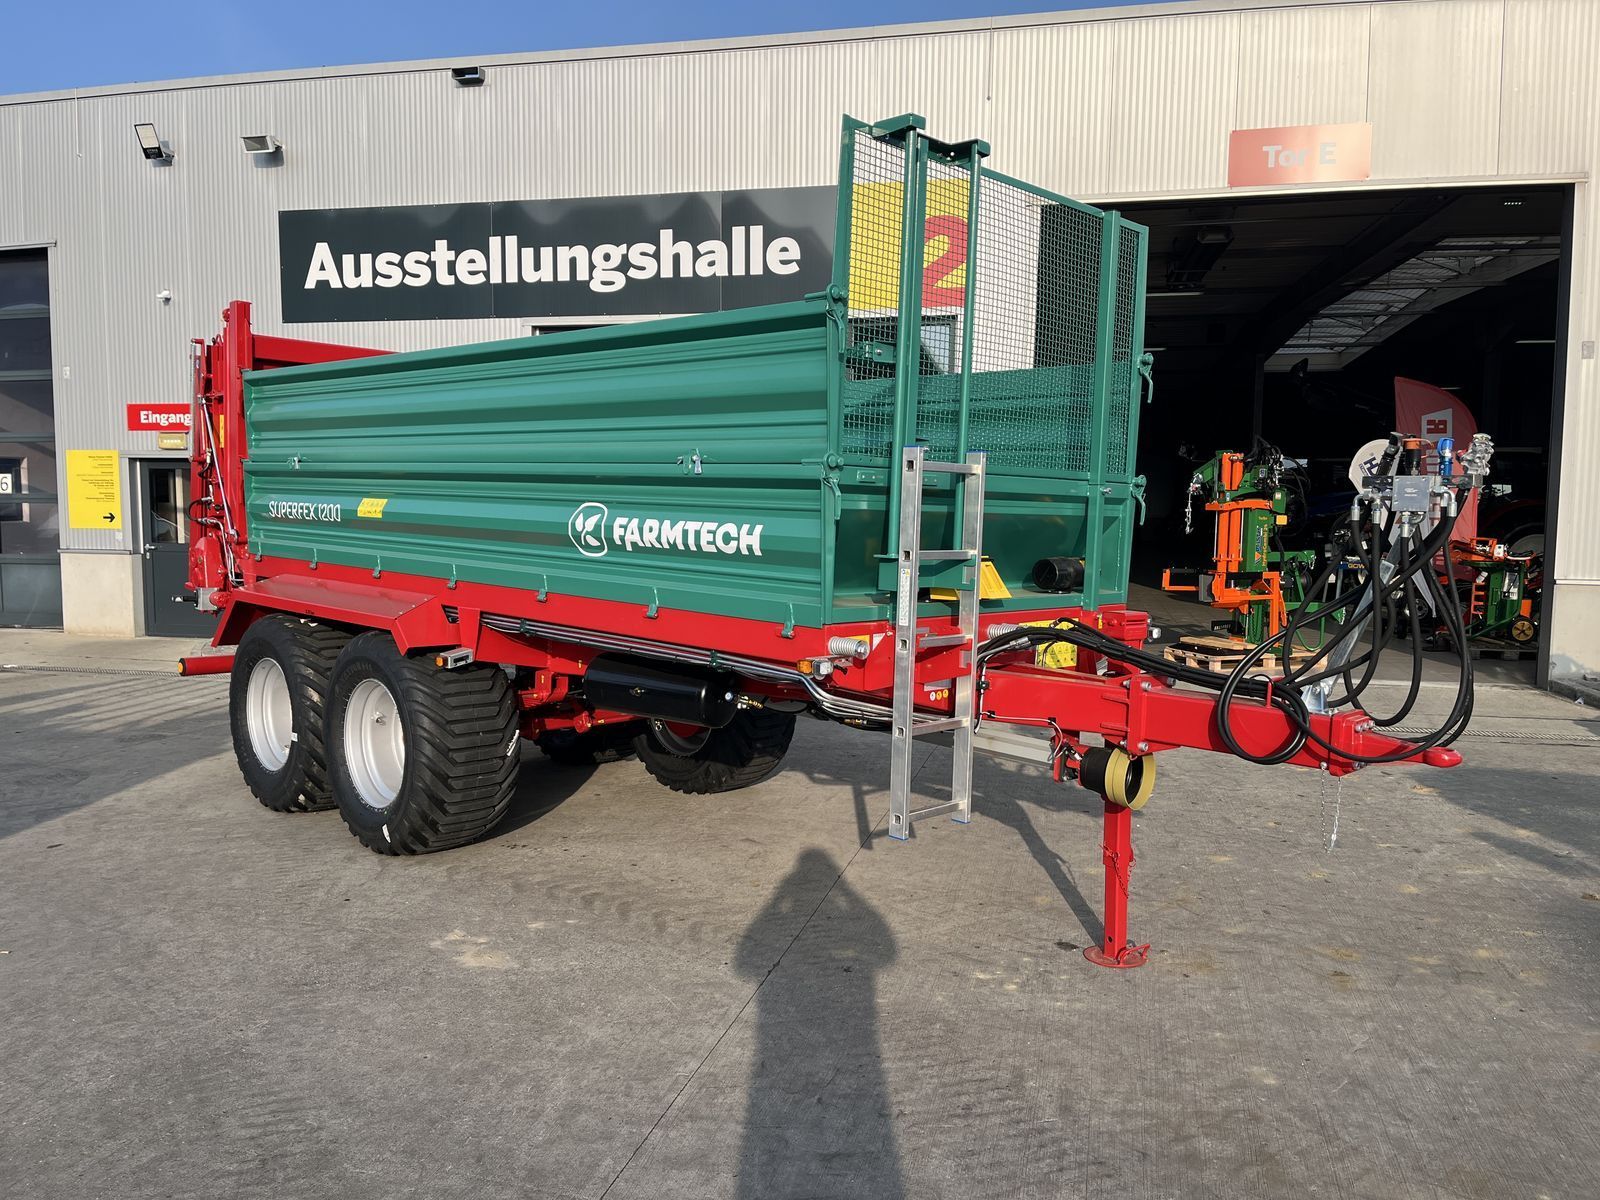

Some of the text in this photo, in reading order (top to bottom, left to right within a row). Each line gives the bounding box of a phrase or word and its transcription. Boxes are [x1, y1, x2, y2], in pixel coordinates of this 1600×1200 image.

[1262, 142, 1337, 168] Tor E
[303, 225, 802, 293] Ausstellungshalle
[922, 214, 968, 308] 2
[139, 410, 192, 427] Eingang
[268, 500, 318, 521] SUPERFEX
[318, 503, 341, 522] 1200
[612, 516, 764, 557] FARMTECH
